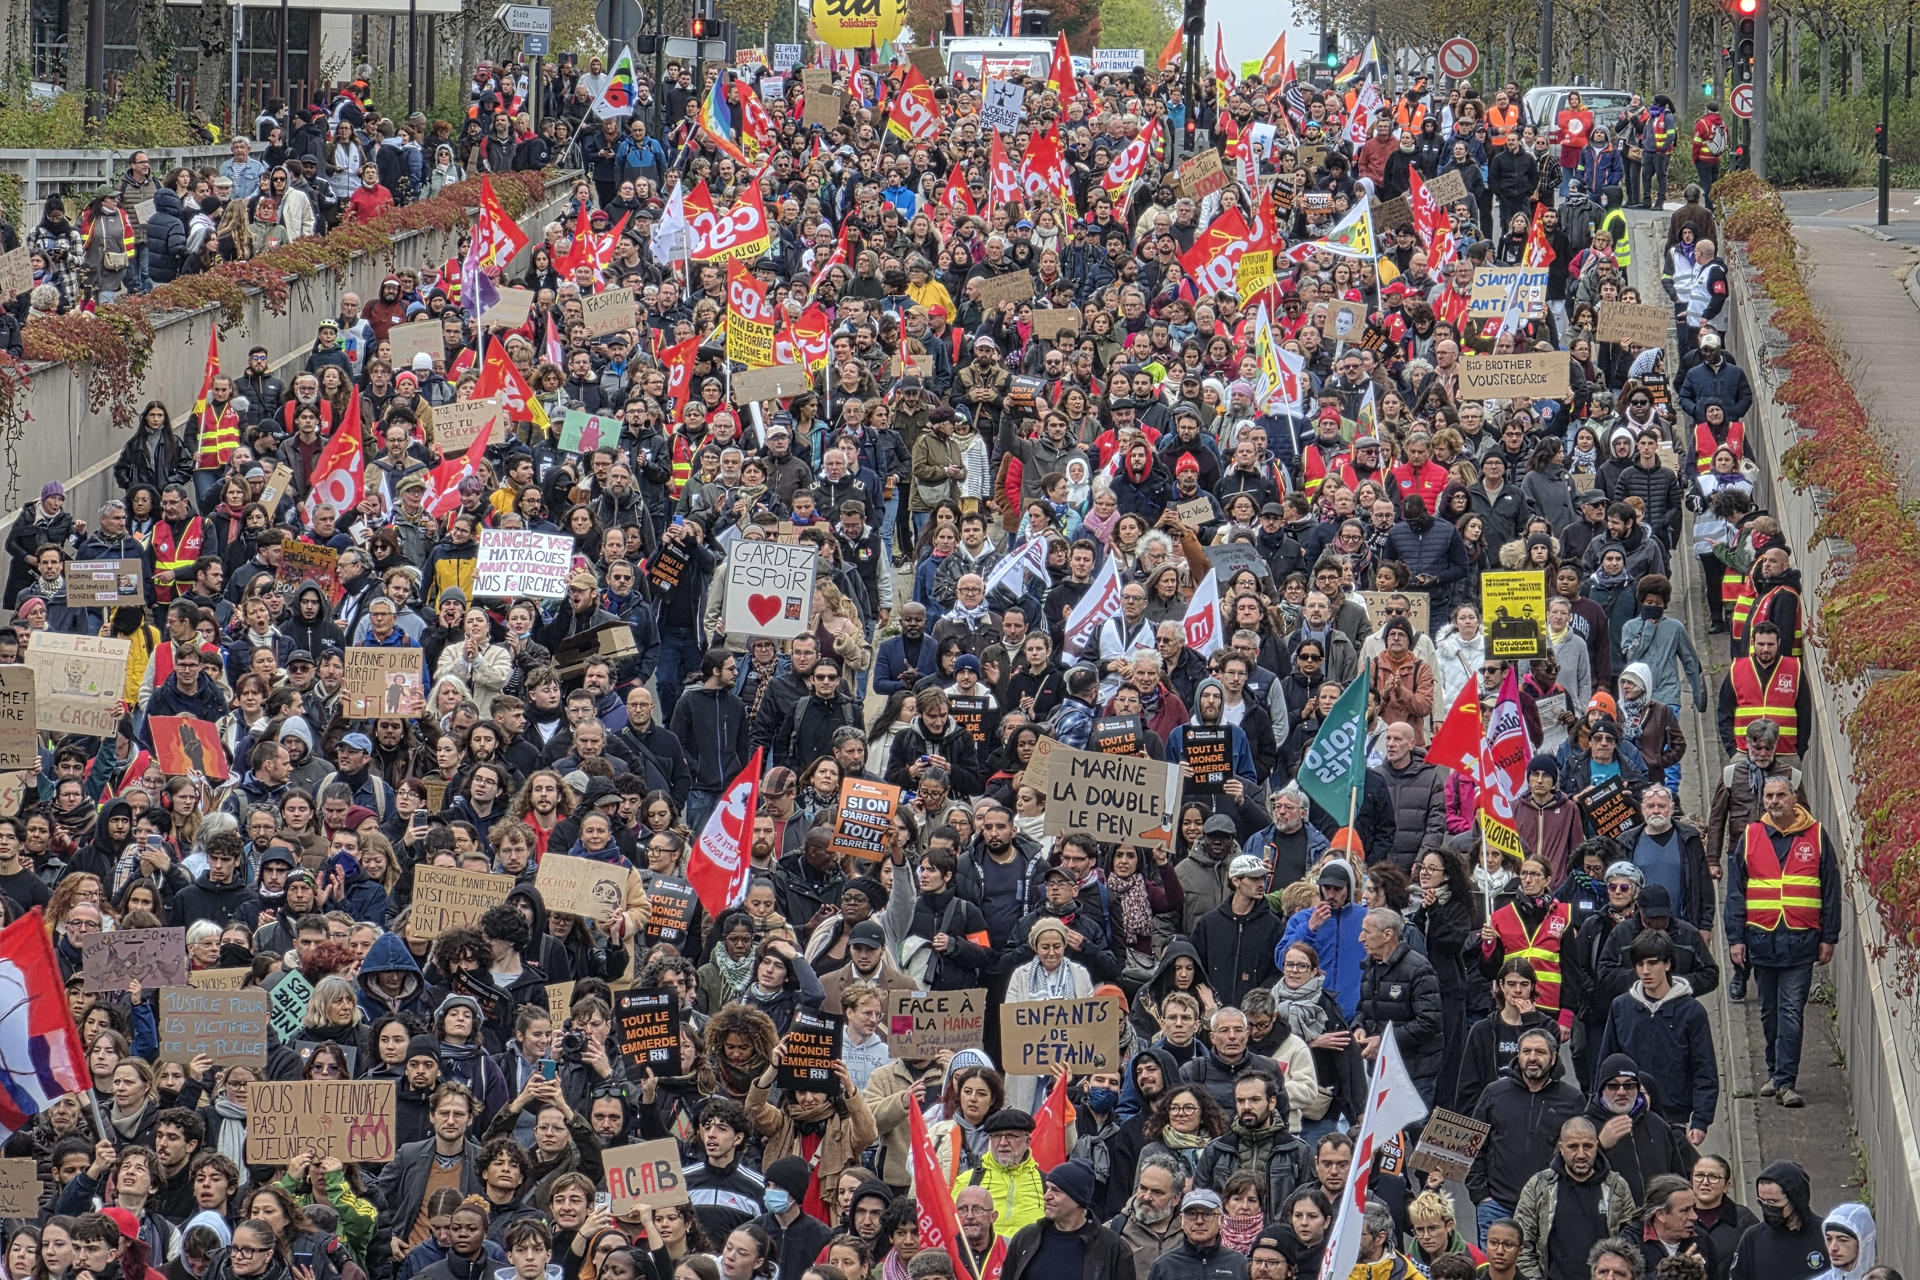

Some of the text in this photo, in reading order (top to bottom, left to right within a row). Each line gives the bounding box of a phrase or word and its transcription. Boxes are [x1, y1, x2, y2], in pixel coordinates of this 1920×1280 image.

[839, 18, 878, 29] Solidaires
[785, 45, 799, 53] PEN
[1096, 61, 1135, 69] NATIONALE
[984, 103, 1018, 120] VOUS NE
[981, 111, 1015, 128] PASSEREZ
[1308, 196, 1328, 204] TOUT
[587, 293, 631, 312] FASHION
[744, 333, 772, 350] FORMES
[1485, 359, 1532, 370] BROTHER
[1467, 373, 1548, 387] VOUS REGARDE
[434, 402, 484, 416] TOI TU VIS
[435, 419, 473, 431] TOI TU
[482, 531, 544, 548] RANGEZ
[489, 551, 565, 563] MATRAQUES
[734, 544, 815, 570] GARDEZ
[474, 576, 501, 593] NOS
[347, 653, 384, 667] JEANNE
[401, 653, 420, 668] ARC
[346, 668, 379, 680] AURAIT
[971, 714, 982, 722] LE
[1099, 733, 1136, 747] TOUT LE
[1187, 743, 1225, 755] TOUT LE
[1189, 753, 1224, 764] MONDE
[1195, 772, 1224, 783] LE RN
[847, 796, 888, 813] SI ON
[1054, 781, 1160, 817] LA DOUBLE
[1590, 793, 1623, 819] TOUT LE
[1071, 805, 1133, 837] LE PEN
[1597, 803, 1627, 826] MONDE
[843, 821, 882, 841] TOUT
[1609, 817, 1633, 839] LE RN
[1491, 824, 1521, 853] LOIRET
[418, 872, 514, 893] LORSQUE MANIFESTER
[416, 888, 442, 903] N'EST
[650, 894, 688, 908] TOUT LE
[415, 917, 433, 932] UN
[649, 914, 688, 930] MMERDE
[647, 926, 677, 939] LE RN
[168, 991, 265, 1013] JUSTICE POUR
[899, 991, 974, 1014] FACE À
[621, 1011, 670, 1028] TOUT LE
[1016, 1001, 1108, 1026] ENFANTS
[165, 1020, 261, 1035] LES VICTIMES
[915, 1017, 937, 1031] LA
[626, 1024, 669, 1040] MONDE
[790, 1031, 834, 1046] TOUT LE
[1050, 1028, 1068, 1042] DE
[164, 1041, 187, 1053] DE
[621, 1036, 678, 1055] EMMERDE
[789, 1044, 831, 1057] MONDE
[634, 1049, 668, 1064] LE RN
[781, 1056, 836, 1070] EMMERDE
[793, 1068, 828, 1080] LE RN
[251, 1084, 293, 1114] VOUS
[252, 1116, 359, 1136] PAS LA EN
[251, 1135, 337, 1161] JEUNESSE
[608, 1159, 680, 1200] ACAB
